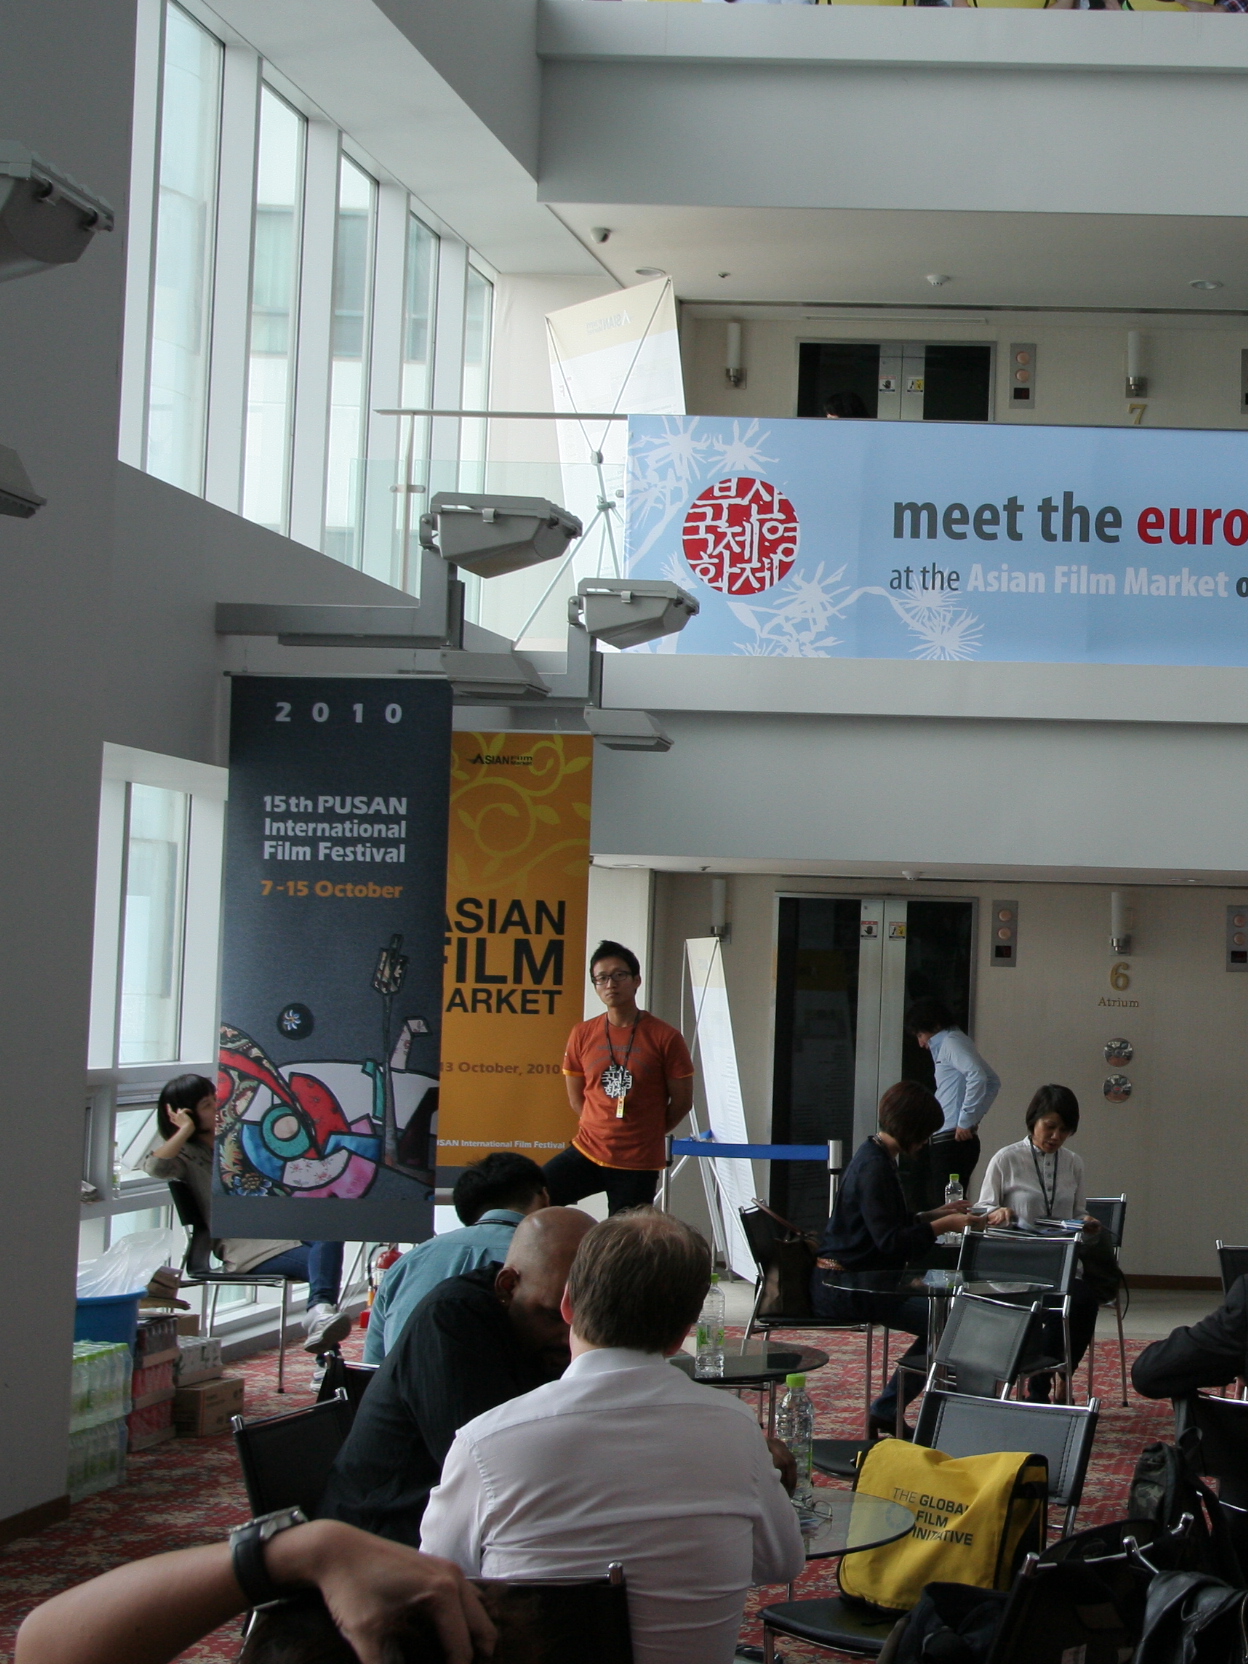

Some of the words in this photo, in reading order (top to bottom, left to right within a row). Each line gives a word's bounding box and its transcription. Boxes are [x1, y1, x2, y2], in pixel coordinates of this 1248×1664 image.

[1129, 403, 1148, 425] 7
[893, 495, 1024, 542] meet
[1037, 491, 1123, 543] the
[889, 566, 913, 591] at
[920, 562, 961, 591] the
[967, 563, 1046, 594] Asian
[1054, 565, 1116, 596] Film
[1124, 566, 1229, 598] Market
[263, 795, 314, 813] 15th
[317, 795, 408, 815] PUSAN
[263, 818, 407, 838] International
[263, 840, 312, 862] Film
[317, 841, 406, 863] Festival
[313, 880, 404, 899] October
[1110, 961, 1130, 991] 6
[1097, 996, 1140, 1008] Atrium
[458, 1061, 523, 1076] October,
[526, 1063, 560, 1075] 2010
[461, 1140, 513, 1148] International
[514, 1140, 532, 1149] Film
[533, 1140, 566, 1149] Festival
[893, 1487, 918, 1504] THE
[916, 1509, 949, 1529] FILM
